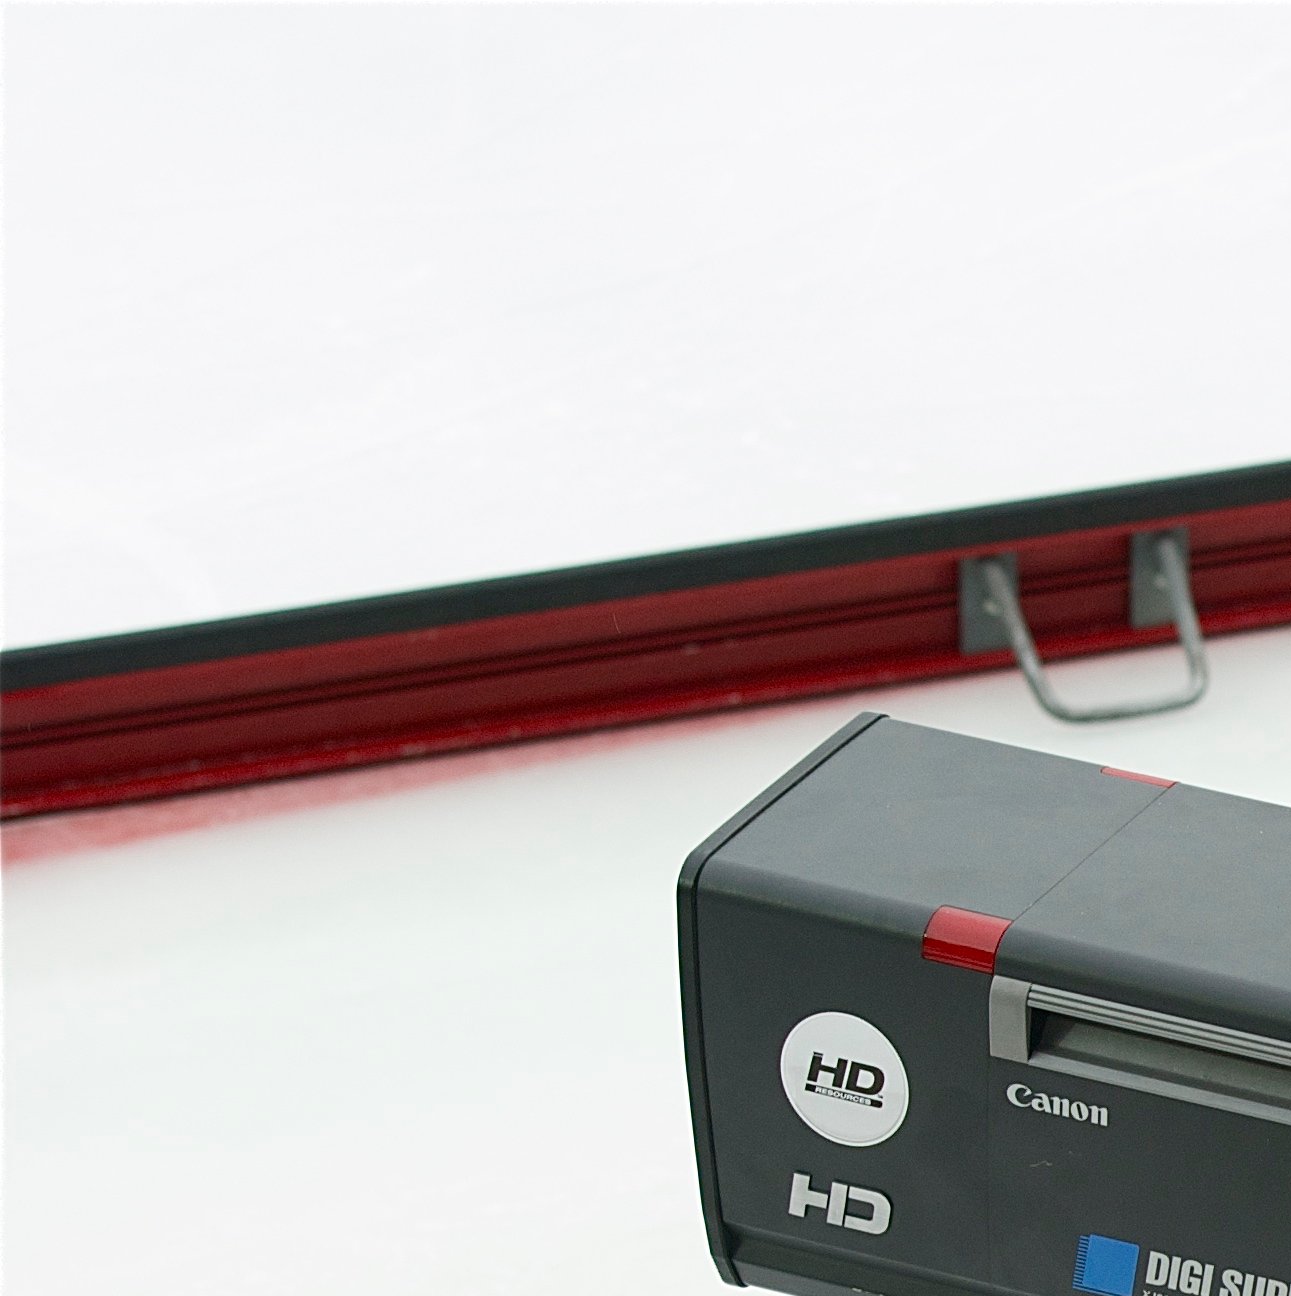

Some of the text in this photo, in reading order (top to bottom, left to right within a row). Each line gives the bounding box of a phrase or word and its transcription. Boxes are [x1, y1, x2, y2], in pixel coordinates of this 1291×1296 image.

[806, 1051, 885, 1096] HD
[815, 1086, 872, 1107] RESOURCES
[1006, 1083, 1108, 1127] Canon
[788, 1172, 892, 1235] HD
